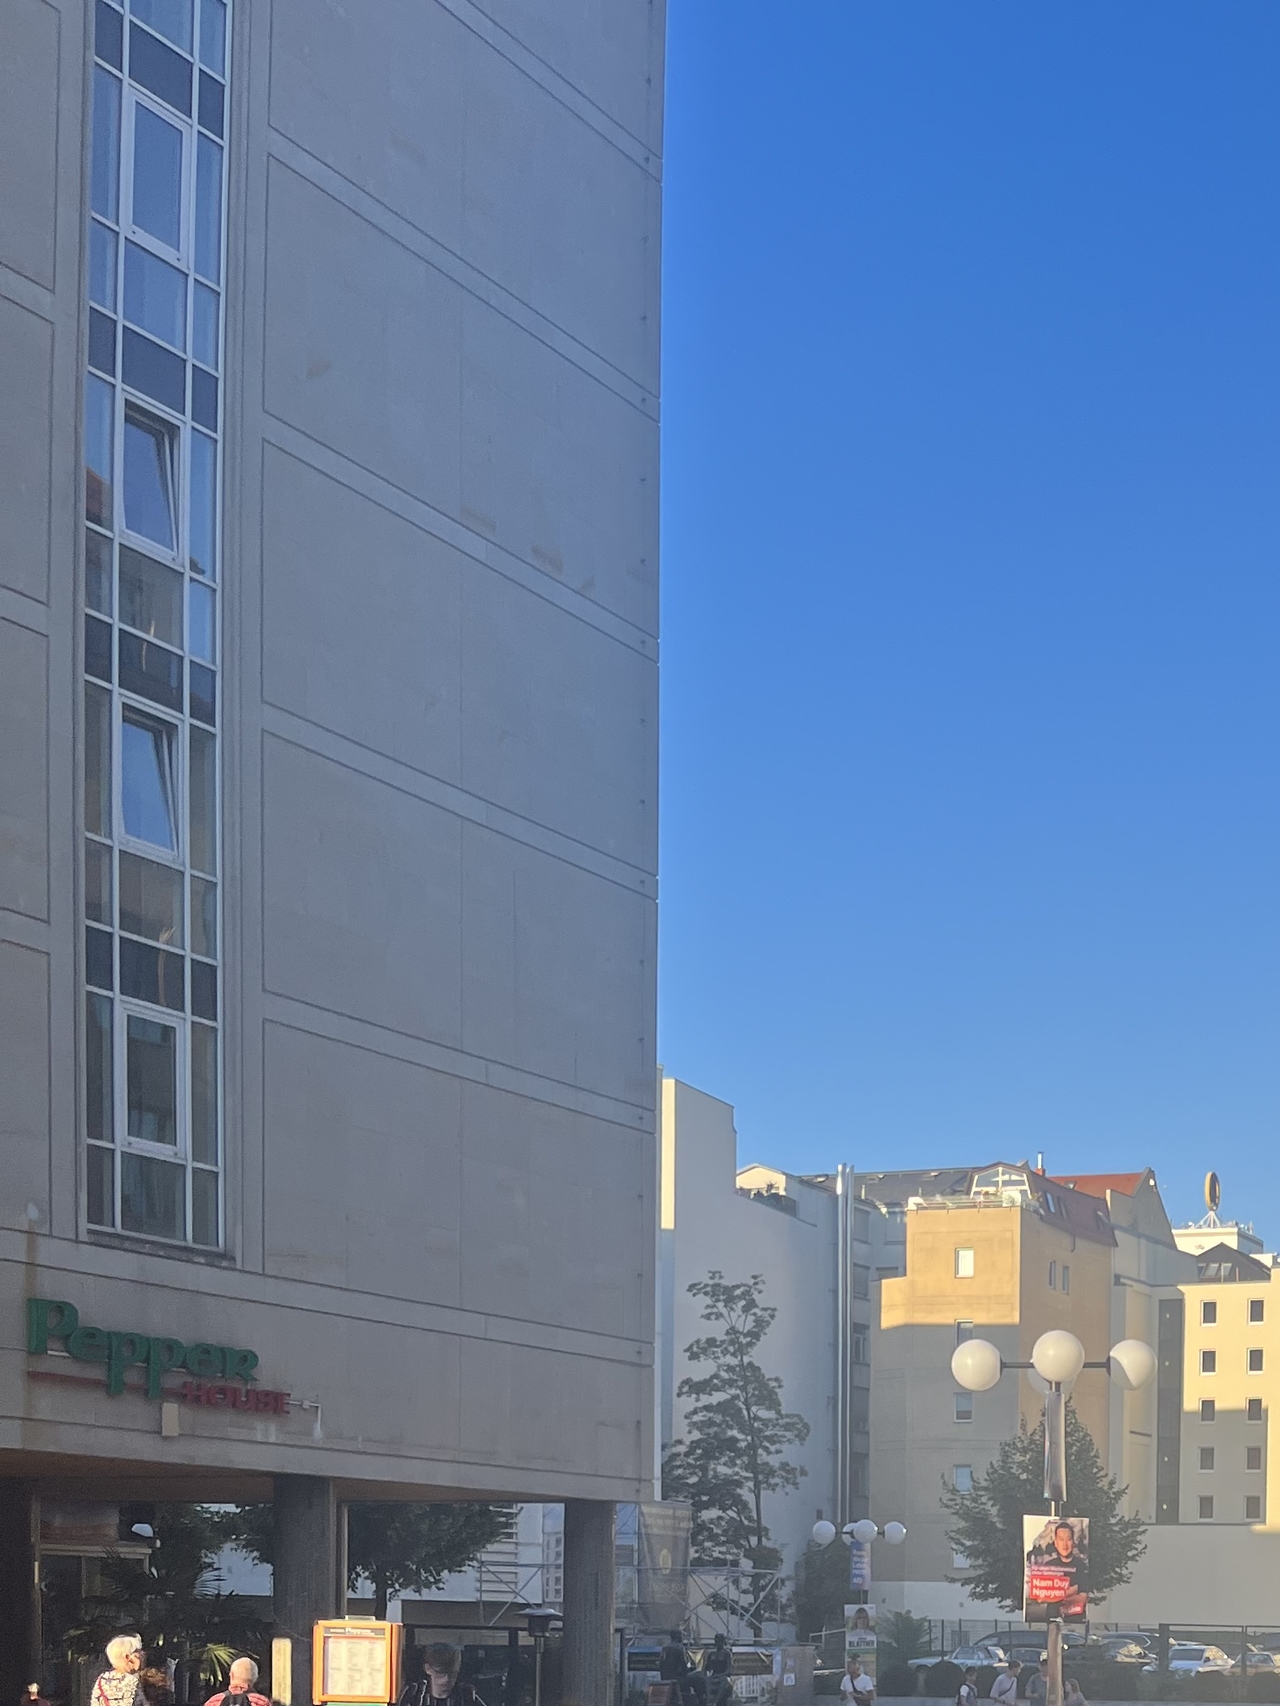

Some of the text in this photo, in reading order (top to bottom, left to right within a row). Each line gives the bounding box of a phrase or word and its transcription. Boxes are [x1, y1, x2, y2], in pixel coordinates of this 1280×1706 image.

[181, 1380, 292, 1415] HOUSE
[1033, 1579, 1069, 1589] Nam Duy
[1033, 1588, 1064, 1598] Nguyen
